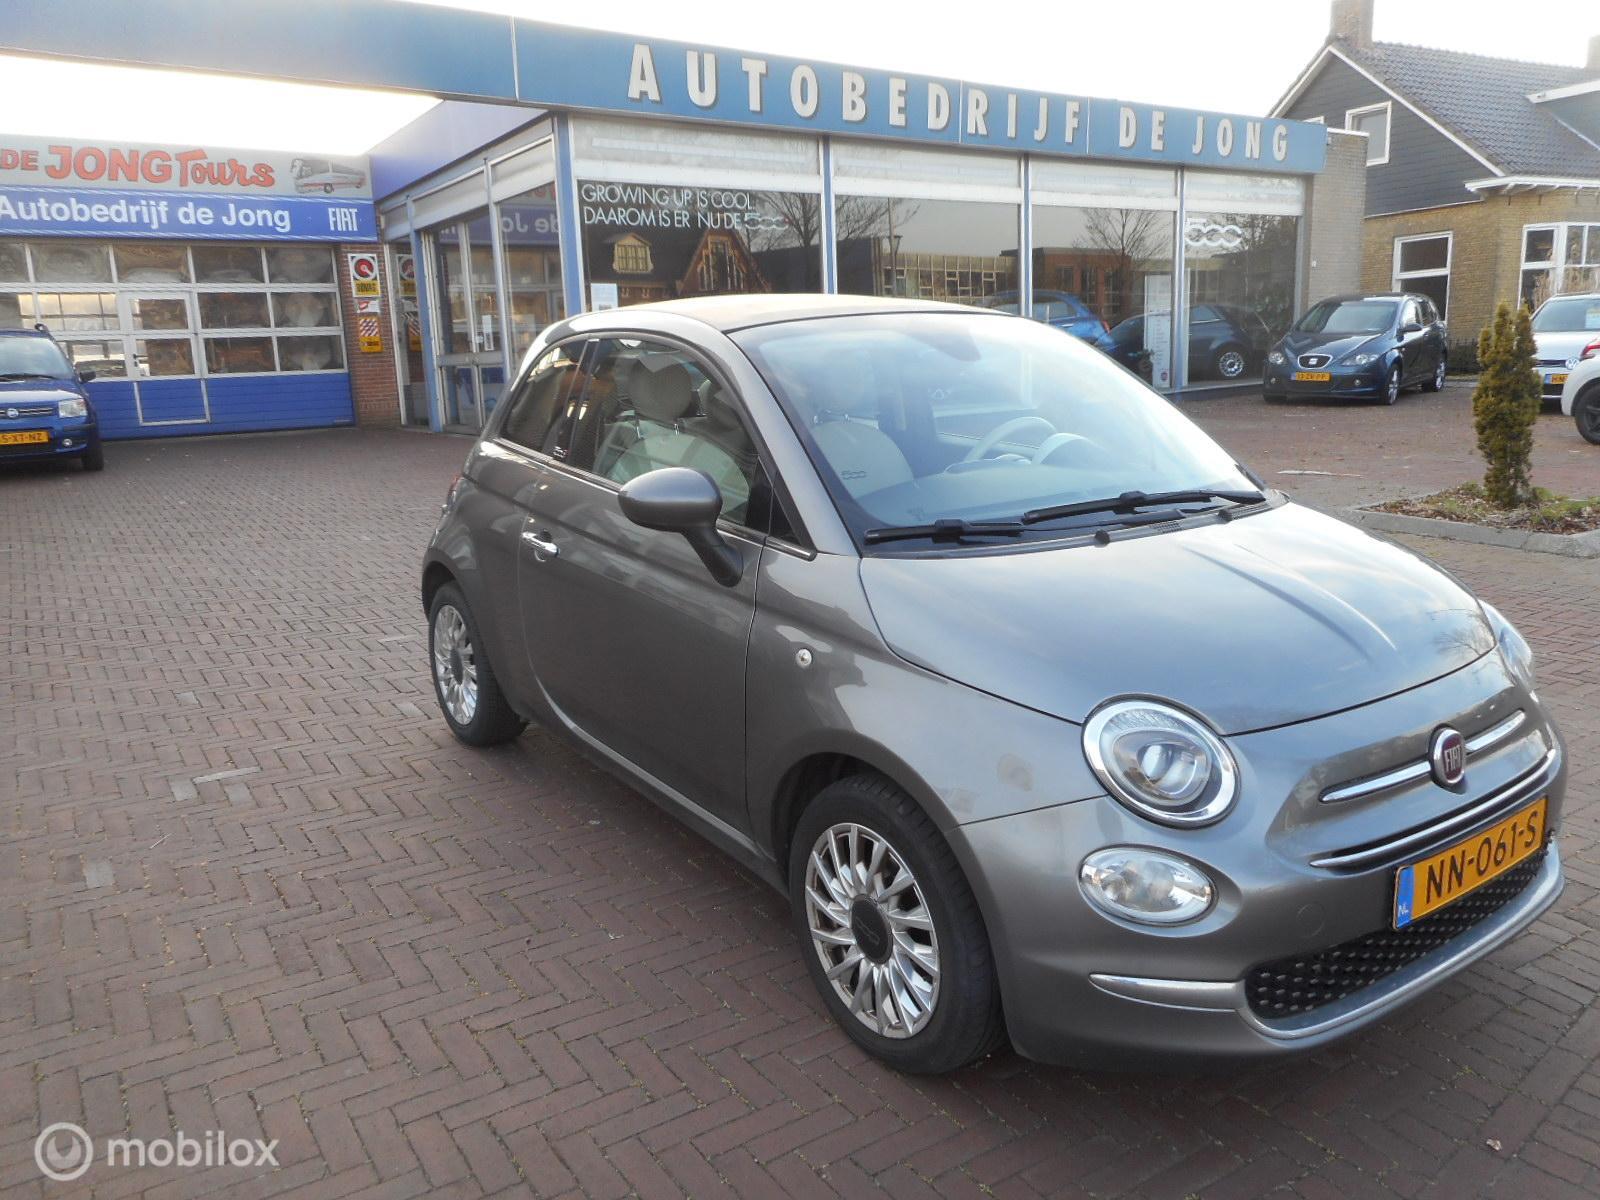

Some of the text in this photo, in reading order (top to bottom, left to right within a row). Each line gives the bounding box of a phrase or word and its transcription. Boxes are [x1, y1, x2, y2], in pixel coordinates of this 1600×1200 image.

[628, 43, 1288, 162] AUTOBEDRIJF DE JONG
[0, 145, 276, 187] DE JONG Tours
[581, 183, 670, 206] GROWING
[673, 188, 693, 207] UP
[697, 190, 709, 208] IS
[0, 195, 291, 233] Autobedrijf de Jong
[328, 207, 359, 232] FIAT
[583, 205, 657, 227] DAAROM
[658, 209, 671, 228] IS
[674, 210, 691, 229] ER
[697, 211, 721, 229] NU
[724, 212, 742, 230] DE
[1184, 217, 1242, 247] 500
[1443, 744, 1463, 772] FIAT
[1426, 810, 1539, 905] NN-061-S
